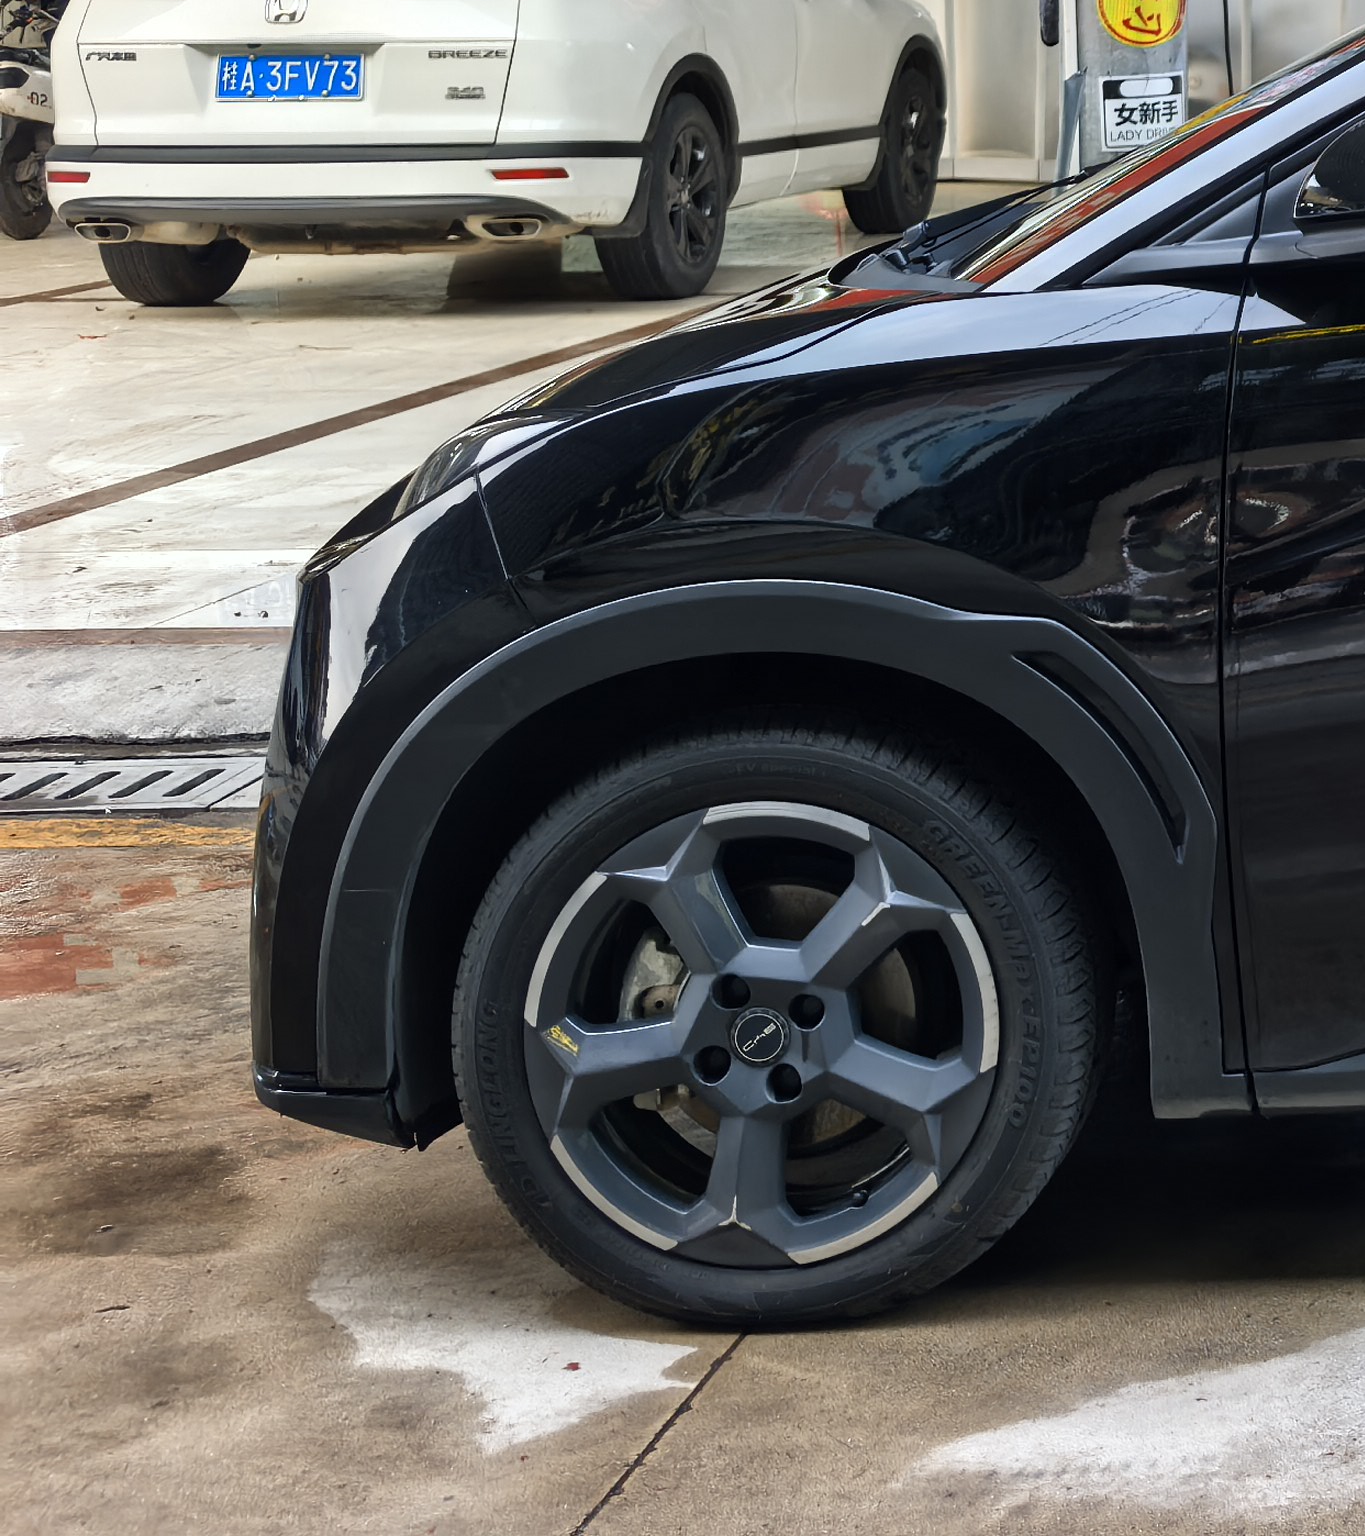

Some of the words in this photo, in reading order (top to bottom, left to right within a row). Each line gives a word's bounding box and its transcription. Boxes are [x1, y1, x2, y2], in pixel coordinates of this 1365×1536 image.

[427, 49, 508, 59] BREEZE
[1113, 99, 1179, 126] 女新手
[1110, 128, 1142, 142] LADY
